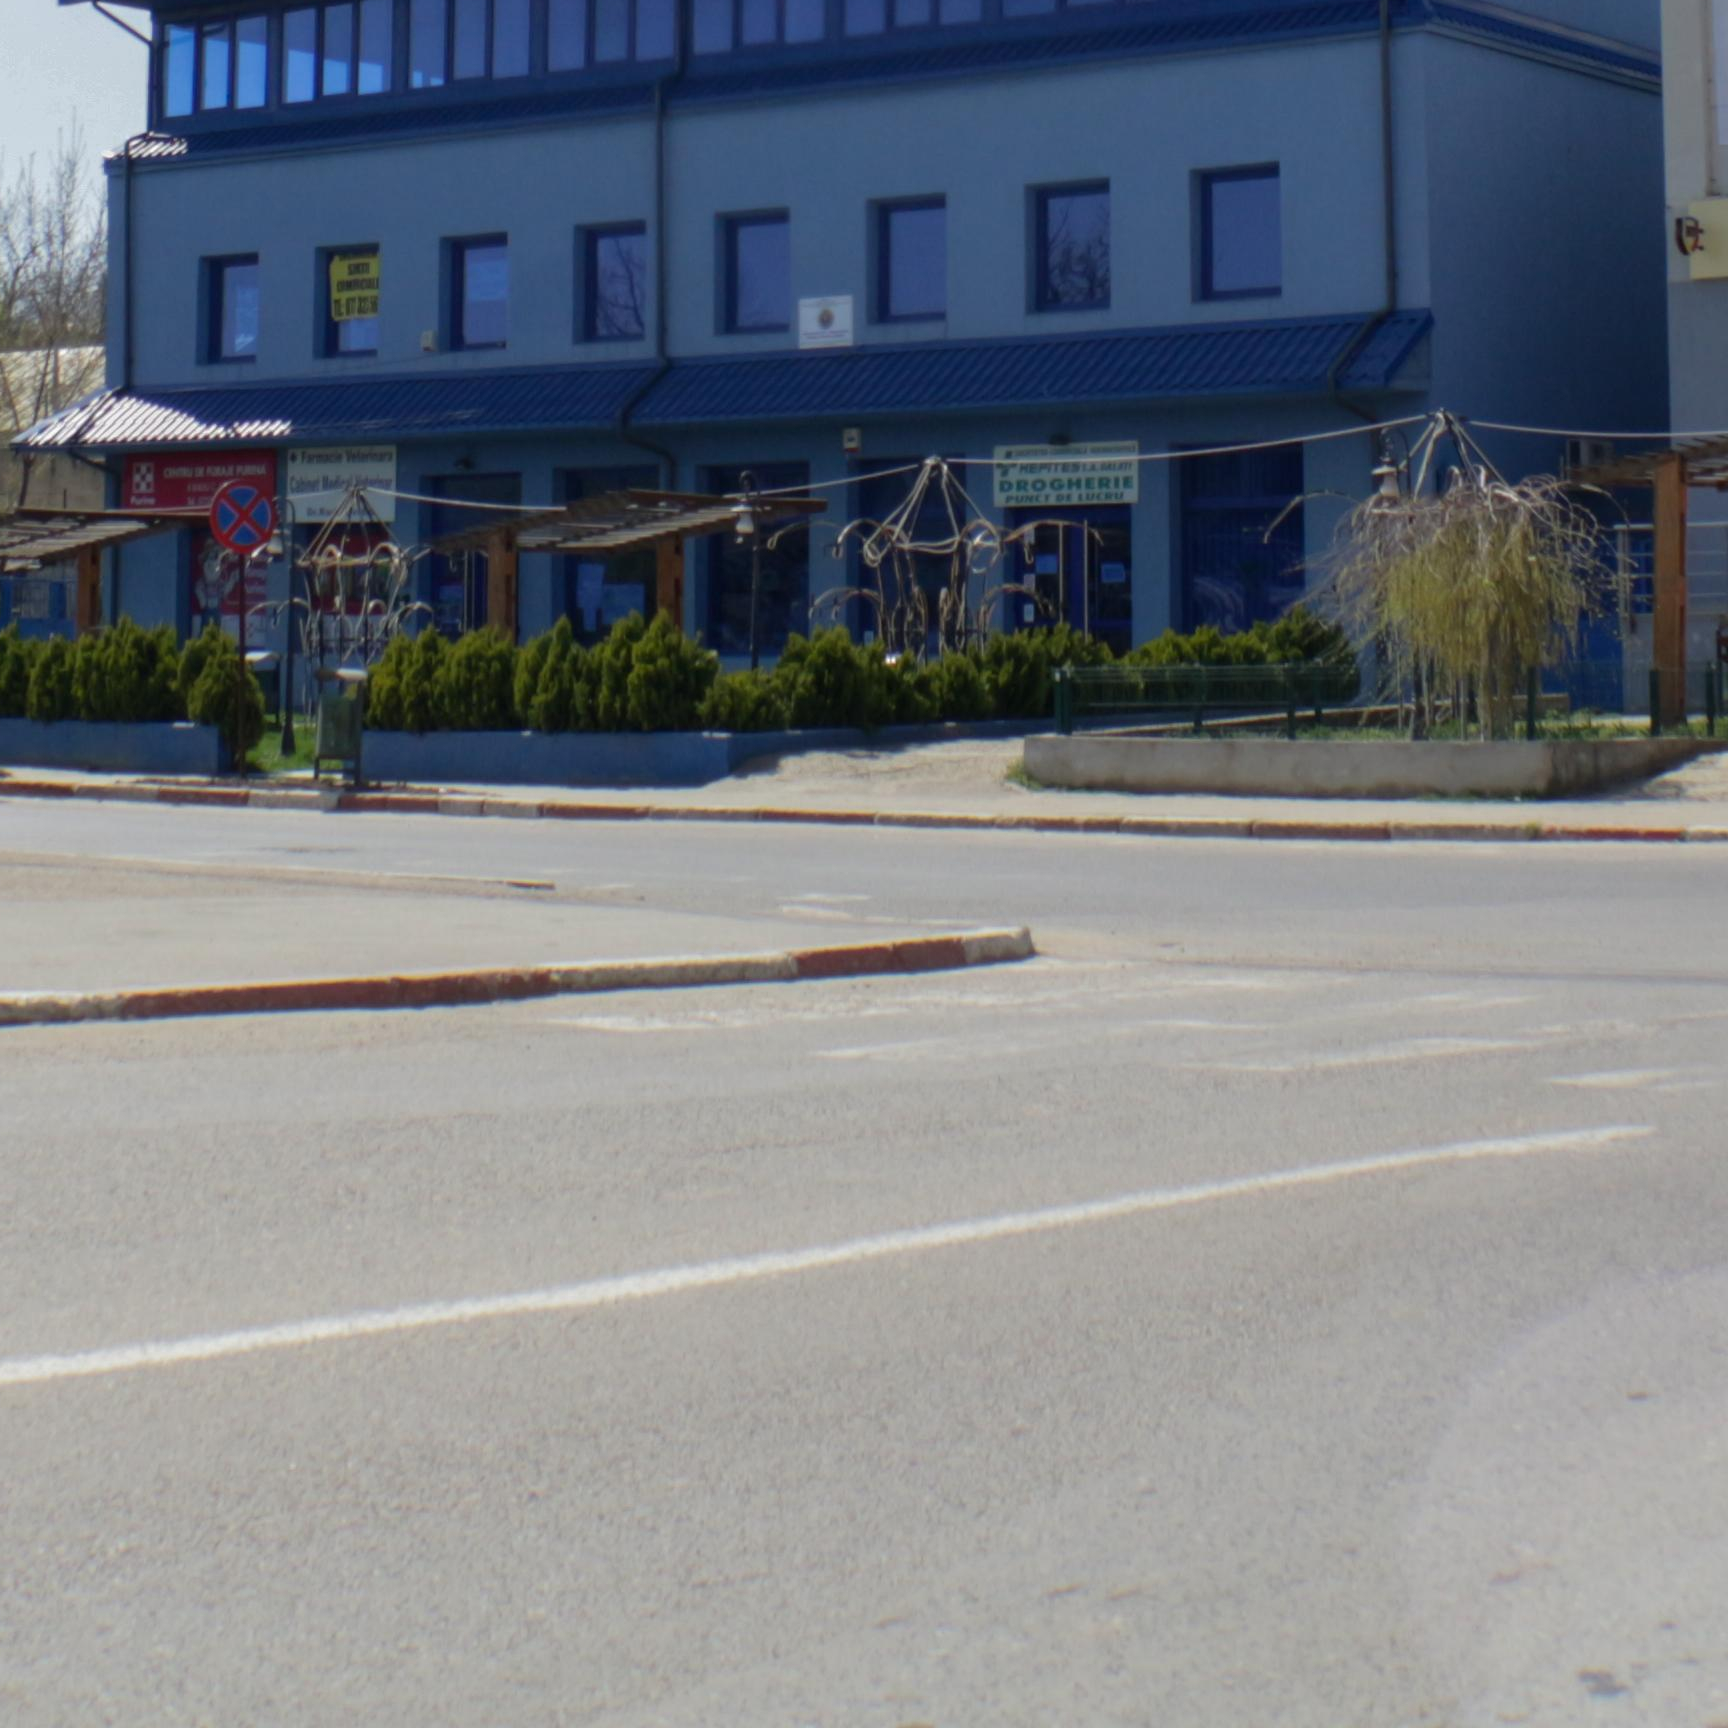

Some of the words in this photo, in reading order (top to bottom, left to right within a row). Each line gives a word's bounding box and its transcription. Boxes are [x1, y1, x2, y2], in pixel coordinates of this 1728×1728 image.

[999, 475, 1134, 493] DROGHERIE
[1005, 492, 1050, 503] PUNCT
[1056, 492, 1073, 503] DE
[1077, 491, 1125, 502] LUCRU
